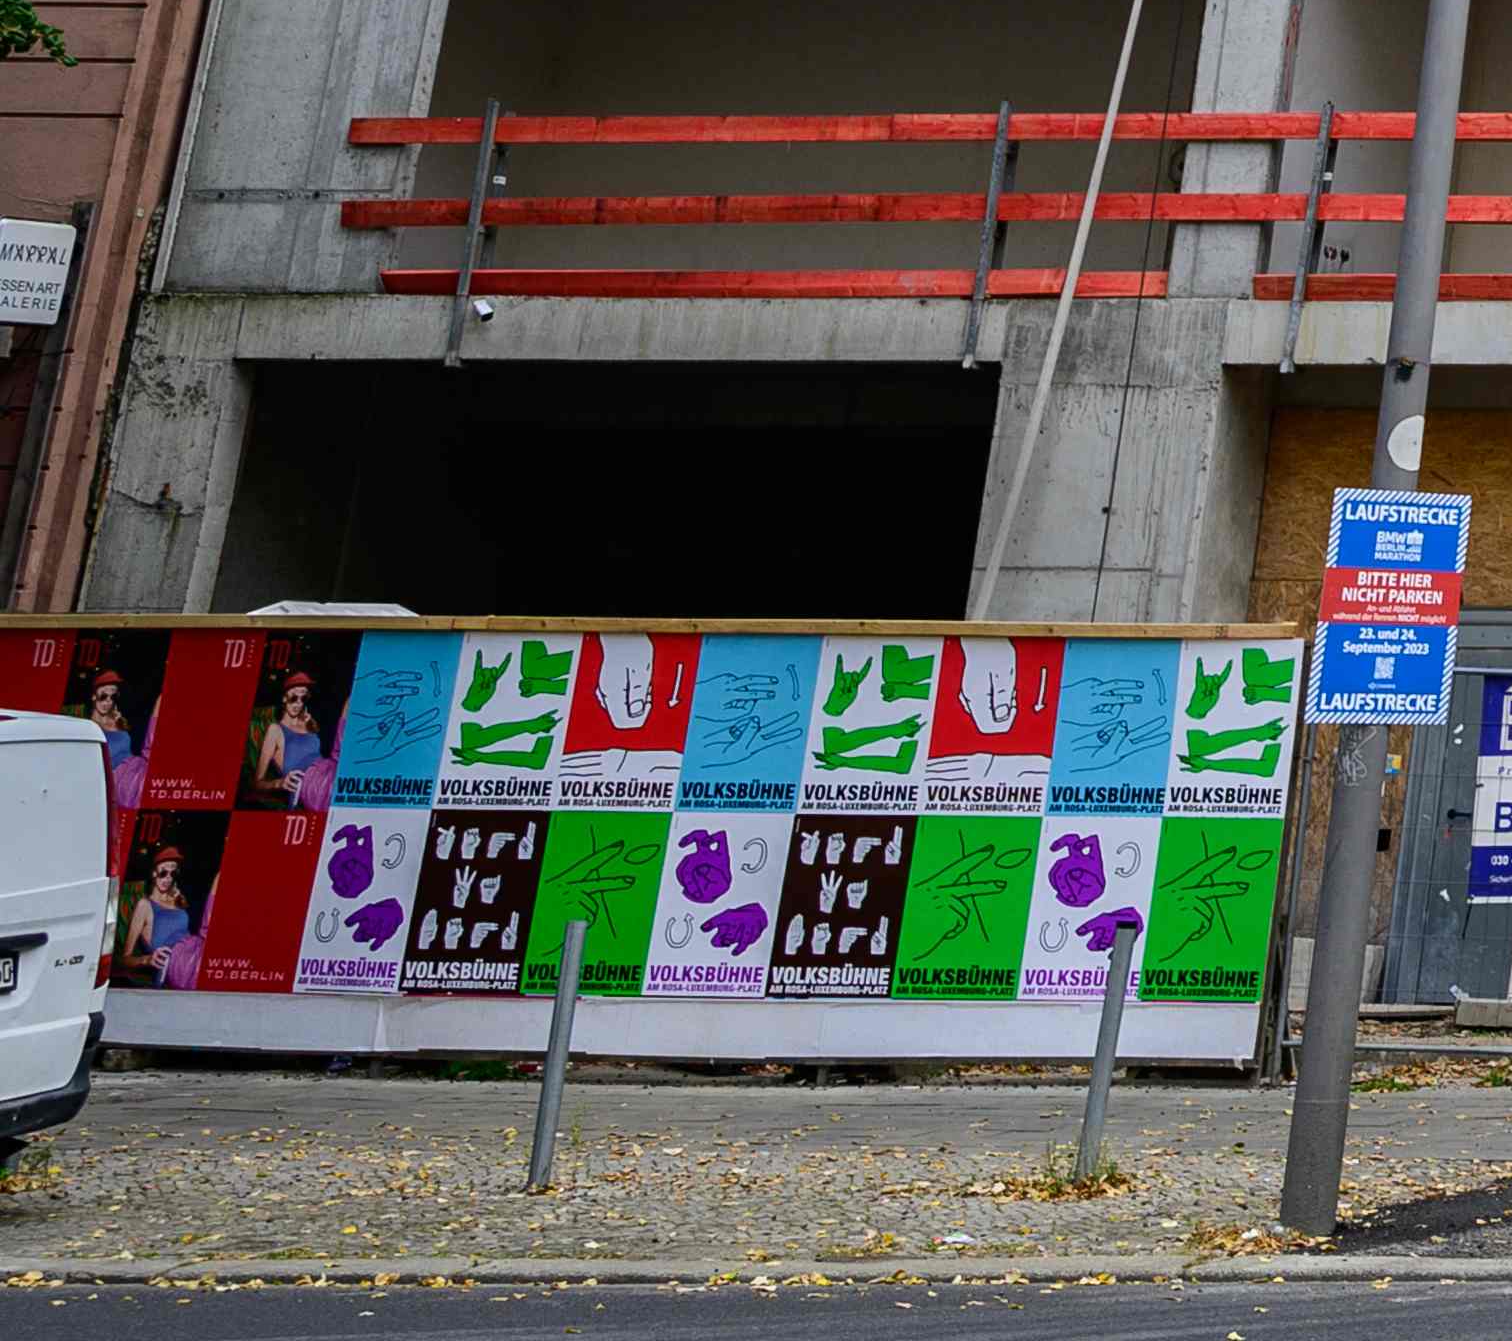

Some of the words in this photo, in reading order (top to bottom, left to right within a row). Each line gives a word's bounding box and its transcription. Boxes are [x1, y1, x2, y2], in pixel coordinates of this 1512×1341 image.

[0, 278, 34, 293] SSEN
[36, 282, 61, 294] ART
[1345, 503, 1459, 525] LAUFSTRECKE
[1376, 530, 1407, 544] BMW
[1374, 552, 1421, 562] MARATHON
[1375, 543, 1406, 552] BERLIN
[1357, 571, 1397, 587] BITTE
[1400, 574, 1432, 588] HIER
[1342, 588, 1387, 603] NICHT
[1388, 589, 1443, 604] PARKEN
[1359, 628, 1376, 639] 23.
[1378, 628, 1399, 639] und
[1401, 629, 1417, 640] 24.
[33, 639, 55, 667] TD
[223, 639, 245, 667] TD
[1343, 641, 1402, 656] September
[1403, 643, 1429, 655] 2023
[1320, 693, 1438, 711] LAUFSTRECKE
[151, 779, 196, 788] WWW.
[336, 776, 433, 797] VOLKSBÜHNE
[440, 777, 552, 797] VOLKSBÜHNE
[560, 778, 674, 799] VOLKSBÜHNE
[682, 780, 796, 800] VOLKSBÜHNE
[804, 781, 919, 802] VOLKSBÜHNE
[927, 783, 1043, 803] VOLKSBÜHNE
[149, 790, 226, 800] TD.BERLIN
[1051, 784, 1166, 804] VOLKSBÜHNE
[1170, 785, 1283, 805] VOLKSBÜHNE
[284, 816, 306, 845] TD
[1490, 855, 1509, 866] 030
[207, 958, 254, 968] WWW.
[301, 958, 398, 979] VOLKSBÜHNE
[405, 959, 519, 980] VOLKSBÜHNE
[528, 961, 641, 981] VOLBÜHNE
[650, 962, 764, 983] VOLKSBÜHNE
[206, 969, 285, 981] TD.BERLIN
[772, 964, 890, 985] VOLKSBÜHNE
[900, 965, 1016, 986] VOLKSBÜHNE
[1025, 967, 1139, 988] VOLKSBÜE
[1144, 967, 1259, 988] VOLKSBÜHNE
